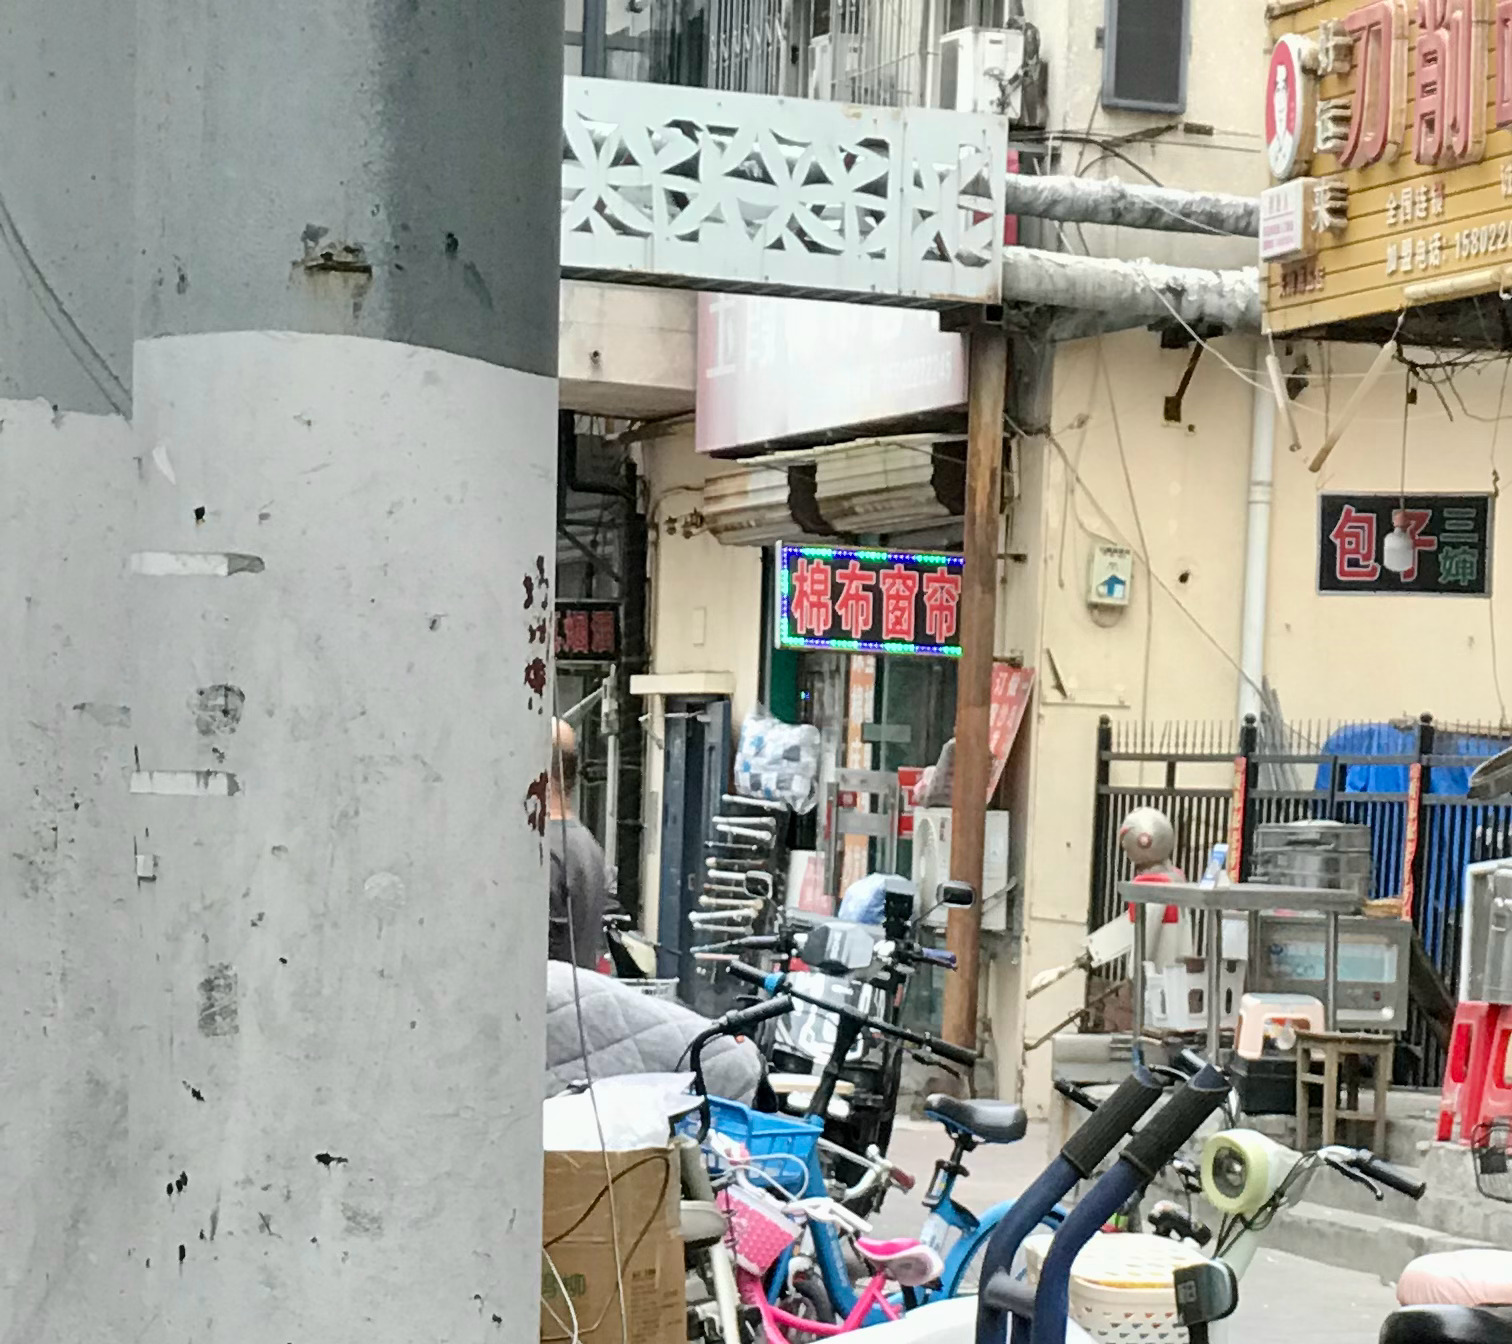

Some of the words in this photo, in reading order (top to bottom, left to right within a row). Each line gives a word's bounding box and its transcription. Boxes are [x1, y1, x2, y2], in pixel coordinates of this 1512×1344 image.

[1330, 504, 1437, 582] 包子
[791, 558, 962, 643] 棉布窗帘
